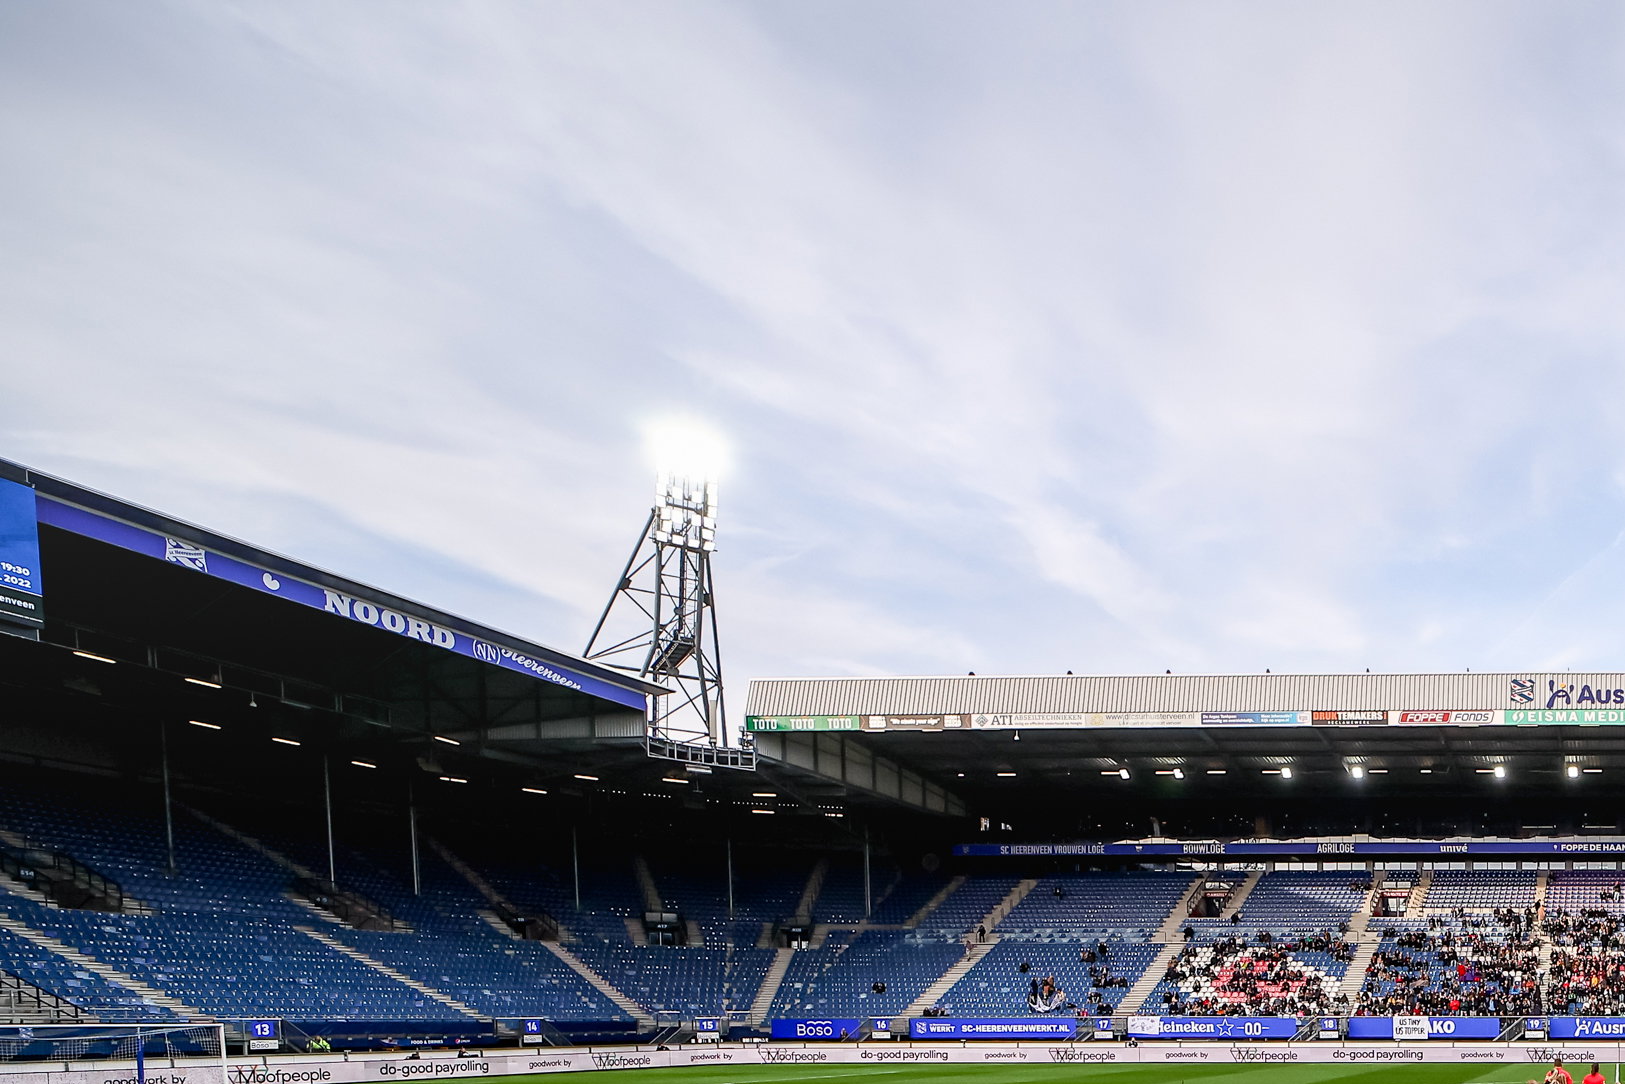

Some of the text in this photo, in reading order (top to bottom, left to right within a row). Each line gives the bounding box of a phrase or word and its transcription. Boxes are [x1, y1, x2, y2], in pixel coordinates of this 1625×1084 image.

[0, 562, 30, 576] 19:30
[3, 574, 32, 589] 2022
[323, 589, 456, 651] NOORD
[475, 641, 498, 663] NN
[990, 714, 1013, 726] ATI
[1406, 713, 1490, 722] FOPPE FONDS
[1528, 711, 1579, 722] EISMA
[752, 718, 777, 730] TOTO
[790, 718, 814, 729] TOTO
[827, 717, 851, 728] TOTO
[1000, 845, 1105, 855] SC HEERENVEEN VROUWEN LOGE
[1183, 844, 1226, 854] BOUWLOGE
[1317, 843, 1354, 853] AGRILOGE
[1440, 843, 1468, 853] univé
[527, 1022, 537, 1031] 14
[702, 1021, 713, 1029] 15
[1098, 1020, 1108, 1029] 17
[1323, 1020, 1334, 1029] 18
[1408, 1018, 1421, 1026] TINY
[1529, 1020, 1539, 1029] 19
[255, 1024, 270, 1036] 13
[797, 1023, 833, 1036] Boso
[961, 1024, 1070, 1033] SC-HEERENVEENWERKT.NL
[690, 1053, 721, 1061] goodwork
[767, 1051, 826, 1063] Moofpeople
[860, 1050, 948, 1062] do-good payrolling
[984, 1052, 1027, 1060] goodwork by
[1057, 1051, 1116, 1063] Moofpeople
[1165, 1051, 1209, 1060] goodwork by
[1238, 1051, 1298, 1063] Moofpeople
[1332, 1050, 1423, 1061] do-good payrolling
[1460, 1051, 1504, 1059] goodwork by
[1534, 1051, 1594, 1062] Moofpeople
[529, 1059, 571, 1070] goodwork by
[599, 1054, 651, 1069] Moofpeople
[379, 1060, 489, 1077] do-good payrolling
